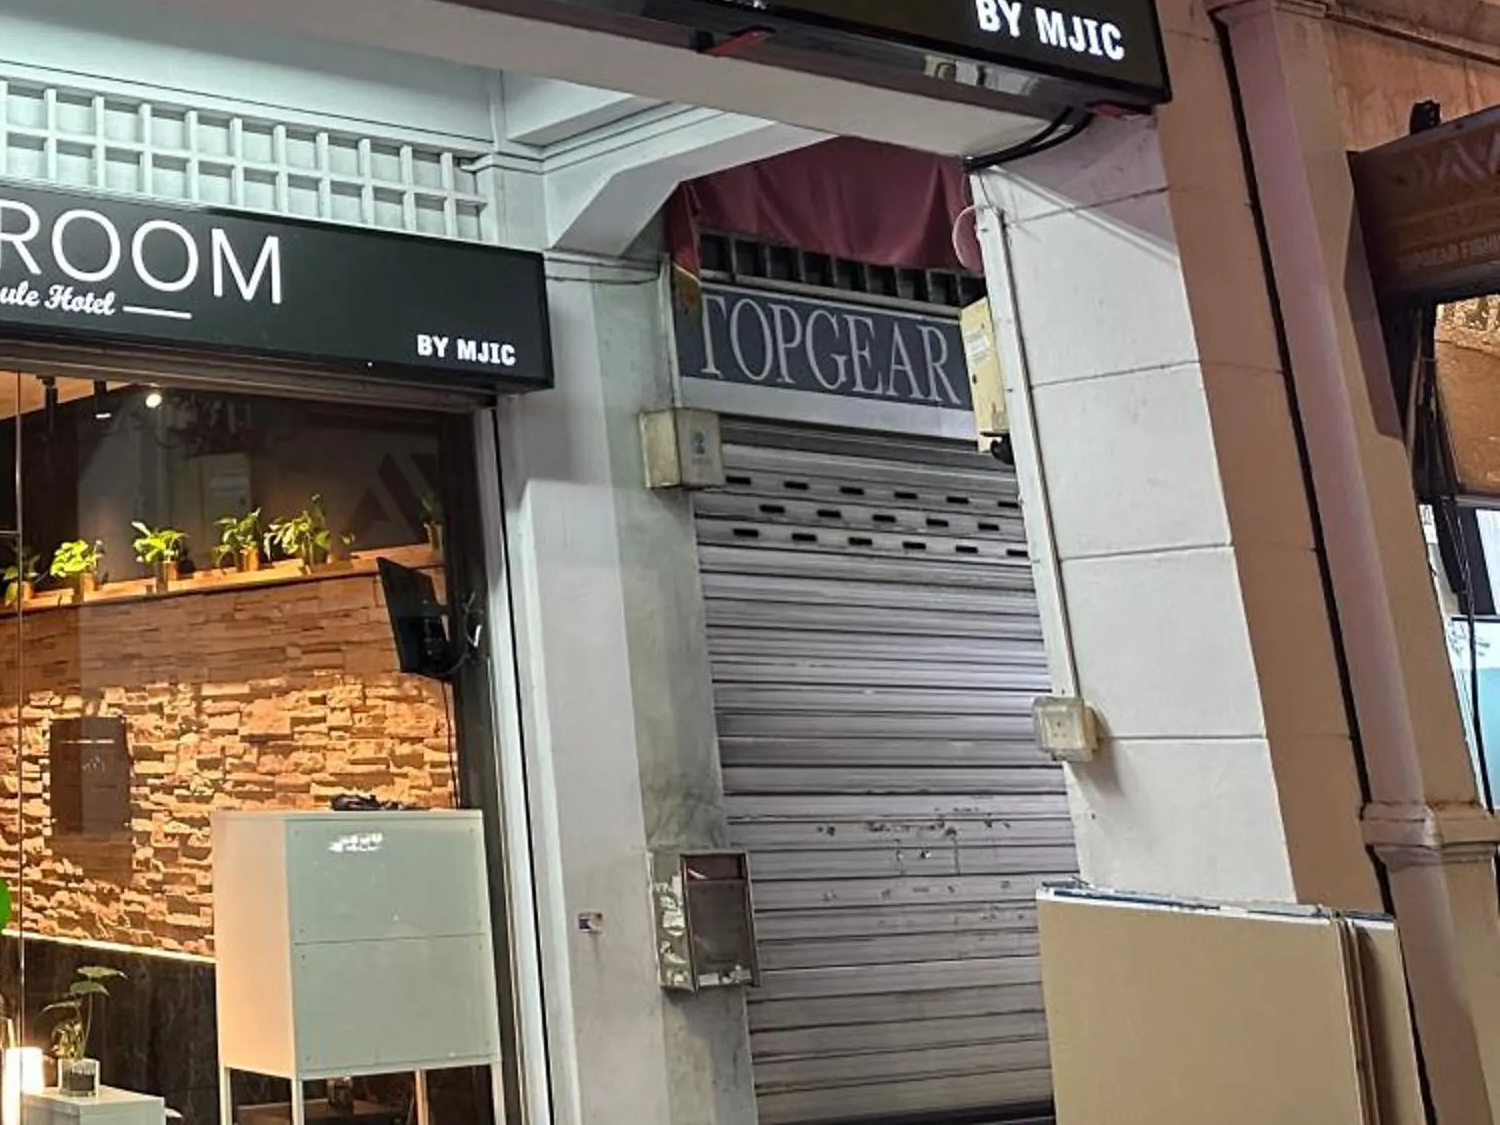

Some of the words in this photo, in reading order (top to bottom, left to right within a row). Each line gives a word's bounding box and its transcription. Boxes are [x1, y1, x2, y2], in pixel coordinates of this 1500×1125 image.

[1035, 6, 1125, 60] MJIC
[43, 284, 117, 316] Hotel
[417, 334, 449, 358] BY
[456, 338, 516, 366] MJIC
[700, 293, 962, 406] TOPGEAR
